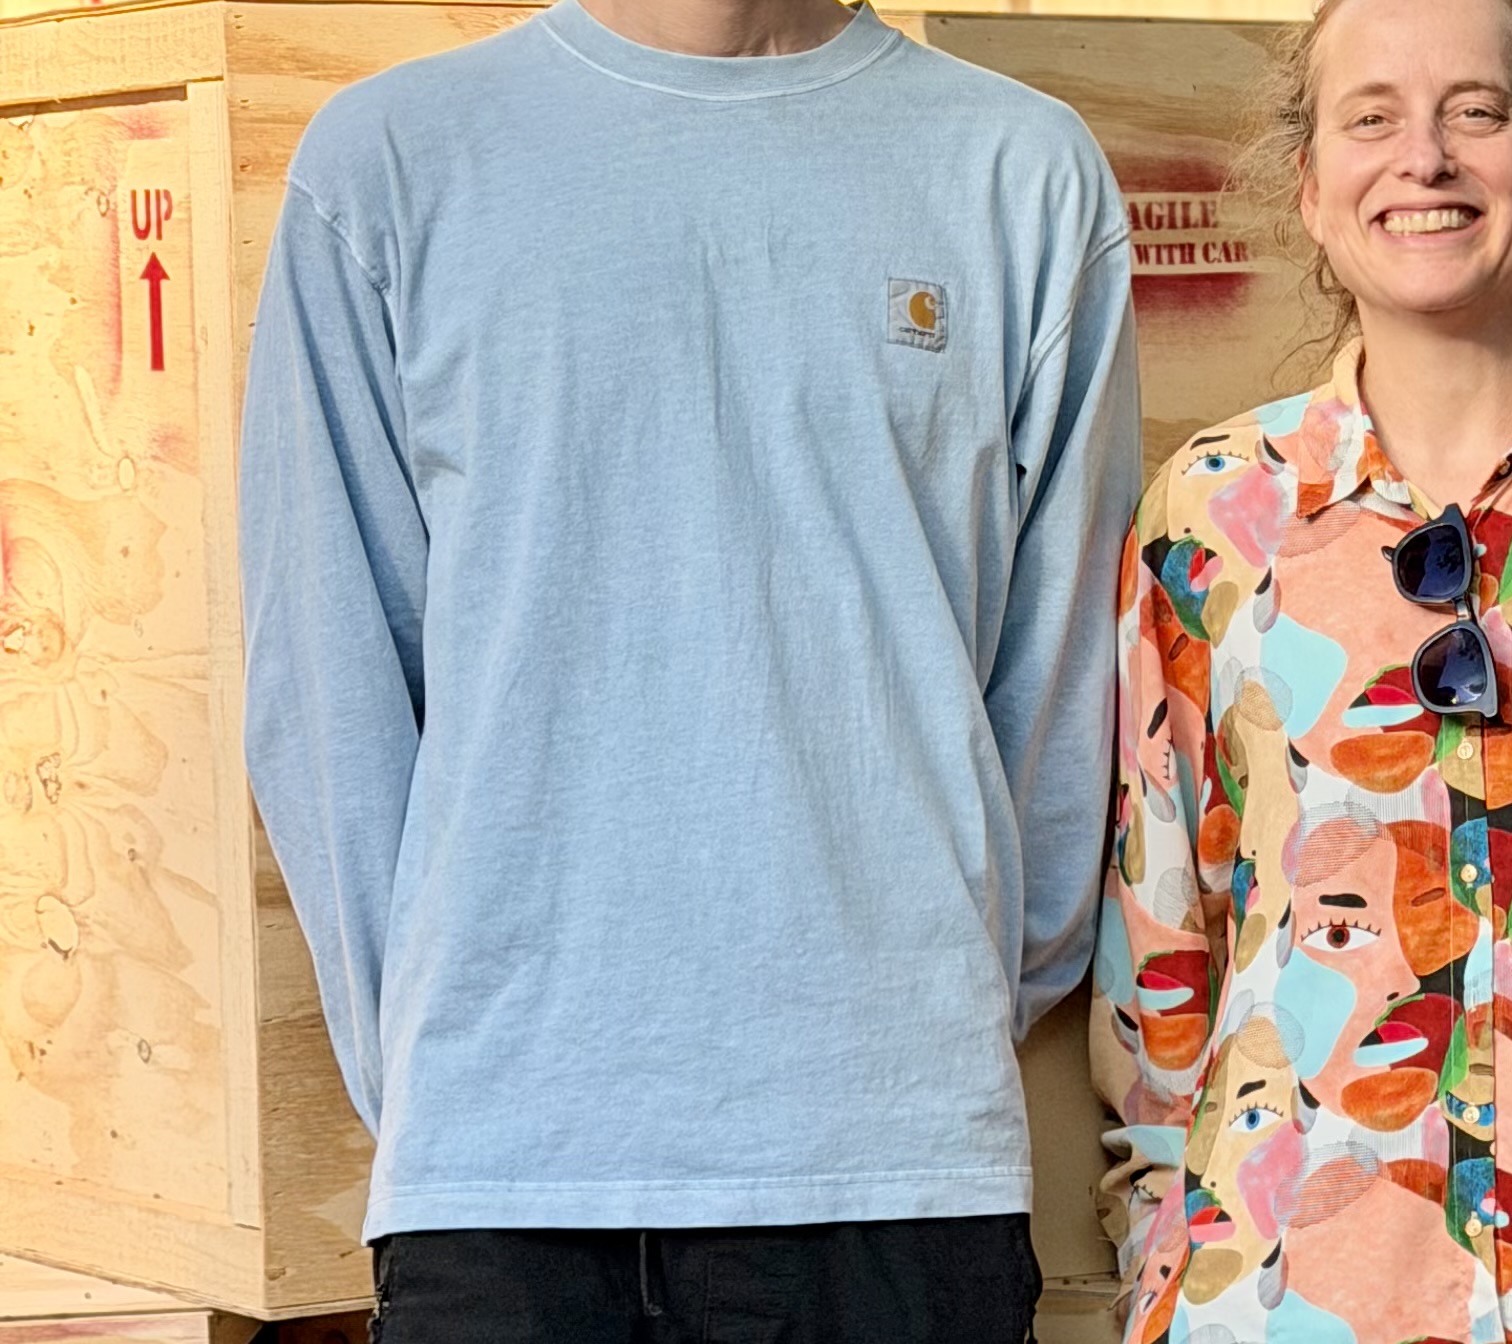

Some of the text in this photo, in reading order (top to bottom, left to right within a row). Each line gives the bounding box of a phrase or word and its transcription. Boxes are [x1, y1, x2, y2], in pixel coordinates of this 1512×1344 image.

[130, 189, 173, 241] UP
[1127, 200, 1219, 231] AGILE
[1133, 239, 1249, 266] WITH CAR
